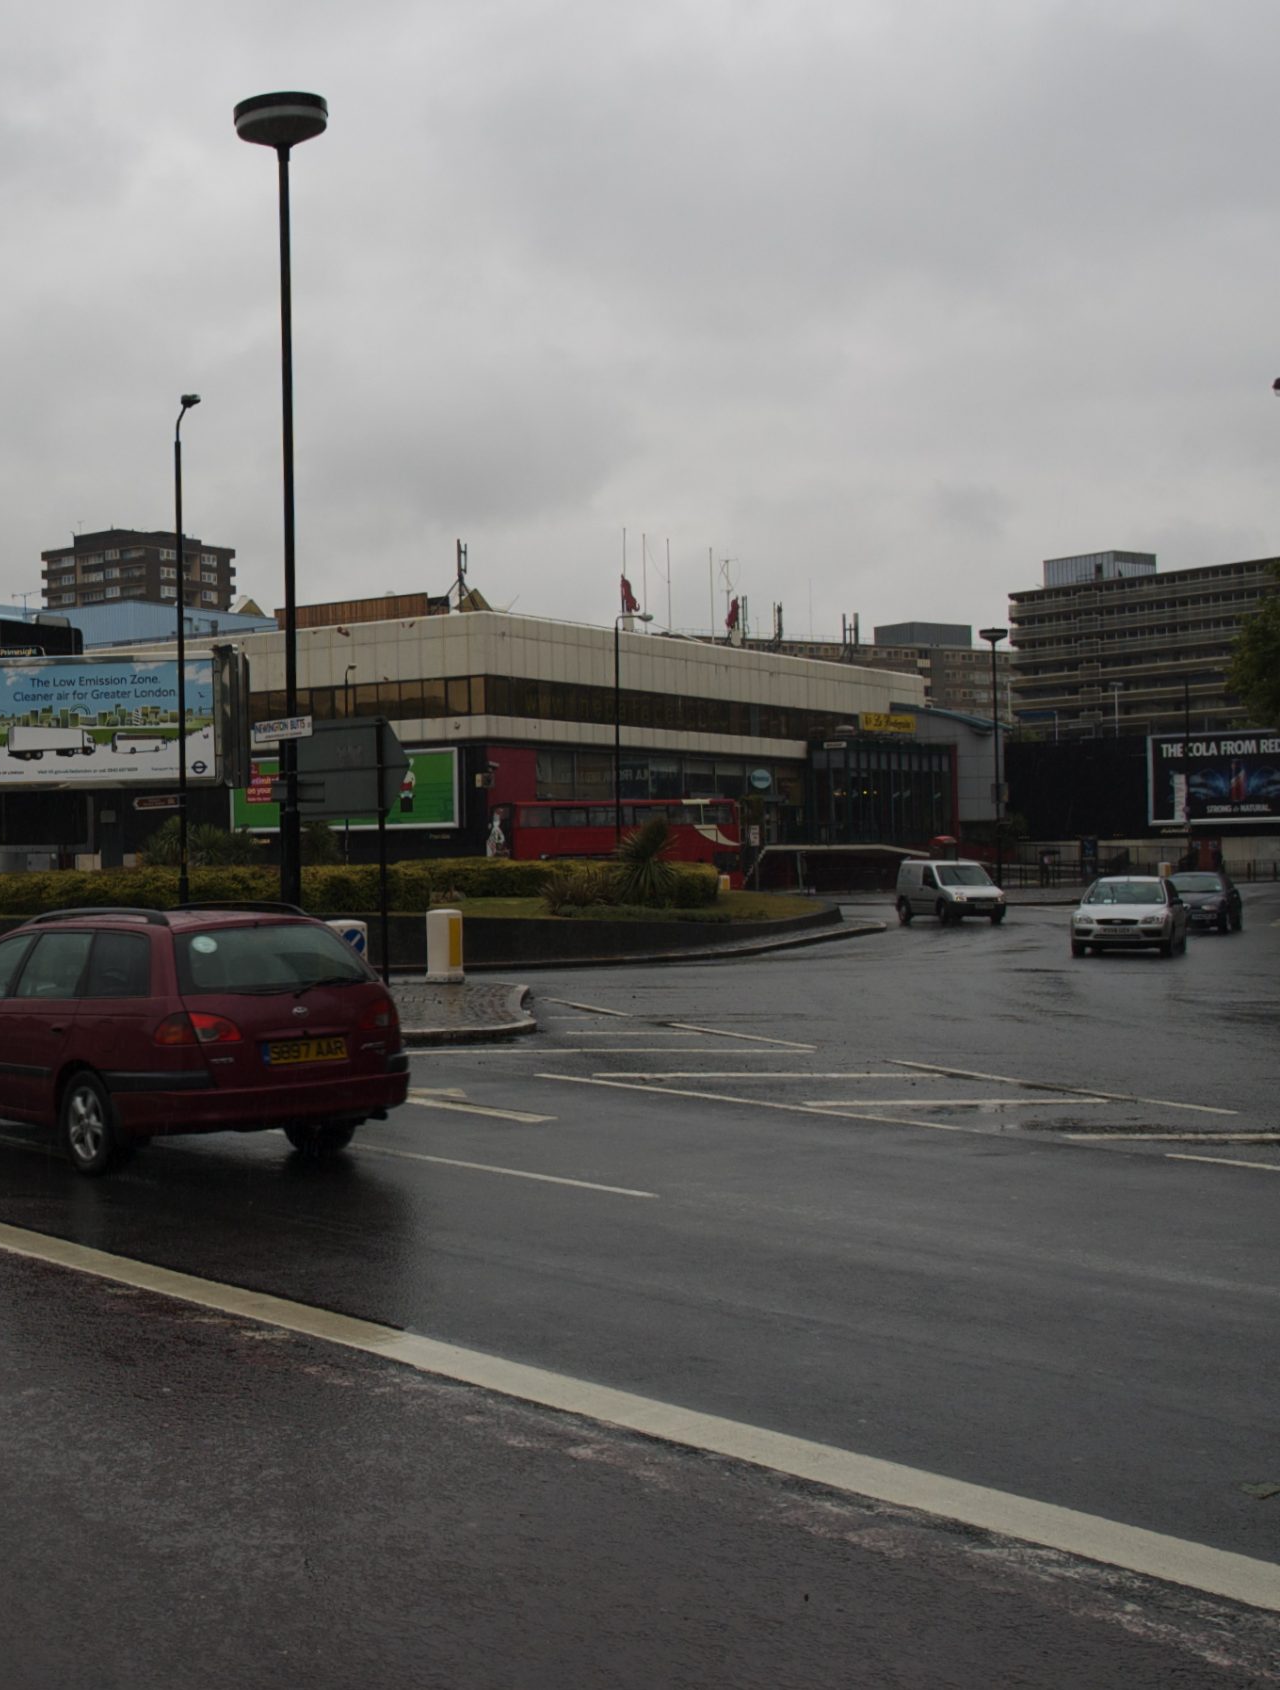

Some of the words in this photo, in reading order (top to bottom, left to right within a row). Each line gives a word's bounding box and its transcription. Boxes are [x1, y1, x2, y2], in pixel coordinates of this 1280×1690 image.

[30, 678, 50, 688] The
[53, 677, 76, 687] Low
[79, 675, 127, 686] Emission
[130, 674, 160, 684] Zone.
[13, 691, 54, 702] Cleaner
[56, 690, 70, 701] air
[72, 690, 88, 700] for
[91, 688, 132, 700] Greater
[255, 720, 288, 733] NEWINGTON
[290, 718, 305, 729] BUTTS
[1161, 743, 1183, 758] THE
[1186, 741, 1218, 757] COLA
[1221, 740, 1257, 755] FROM
[1206, 804, 1232, 813] STRONG
[317, 1039, 345, 1056] AAR
